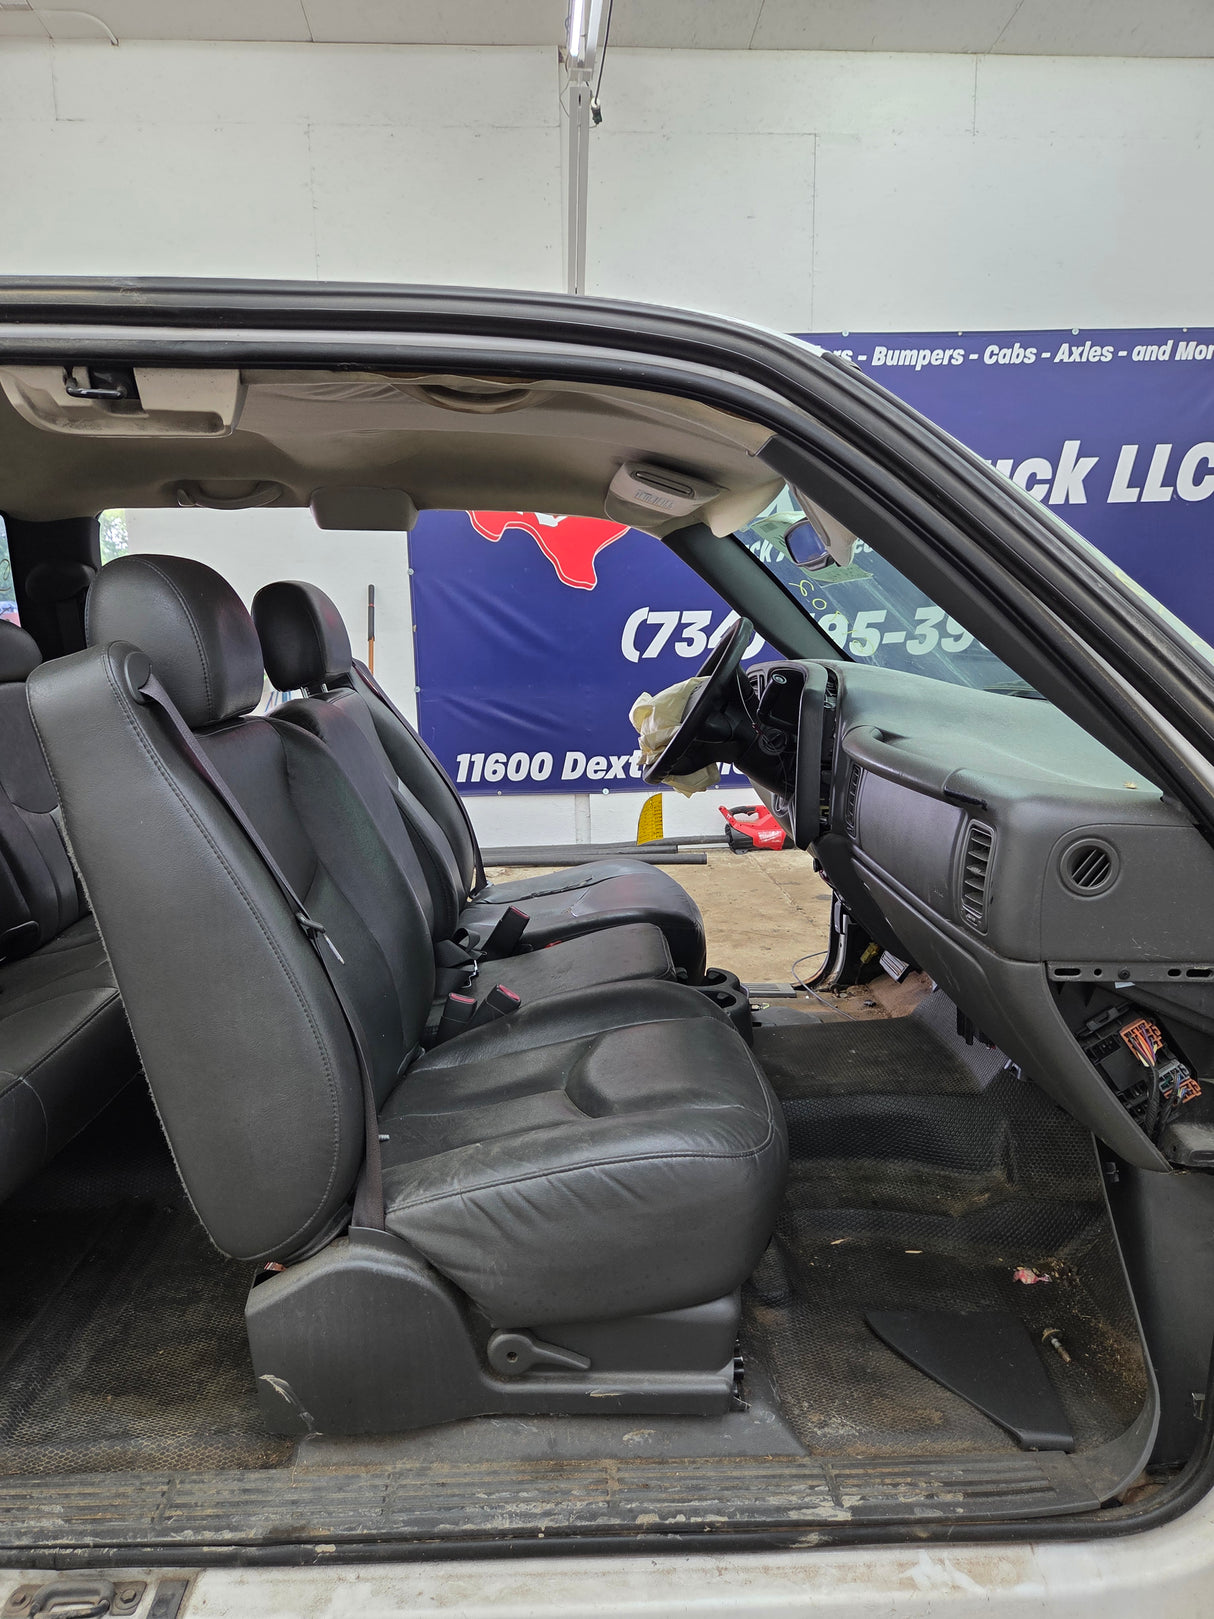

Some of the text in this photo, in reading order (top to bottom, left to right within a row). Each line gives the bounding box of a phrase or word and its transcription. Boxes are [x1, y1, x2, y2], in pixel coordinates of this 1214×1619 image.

[871, 346, 964, 371] Bumpers
[983, 342, 1036, 365] Cabs
[1054, 341, 1114, 362] Axles
[1132, 339, 1174, 361] and
[1107, 441, 1214, 503] LLC
[456, 751, 554, 783] 11600
